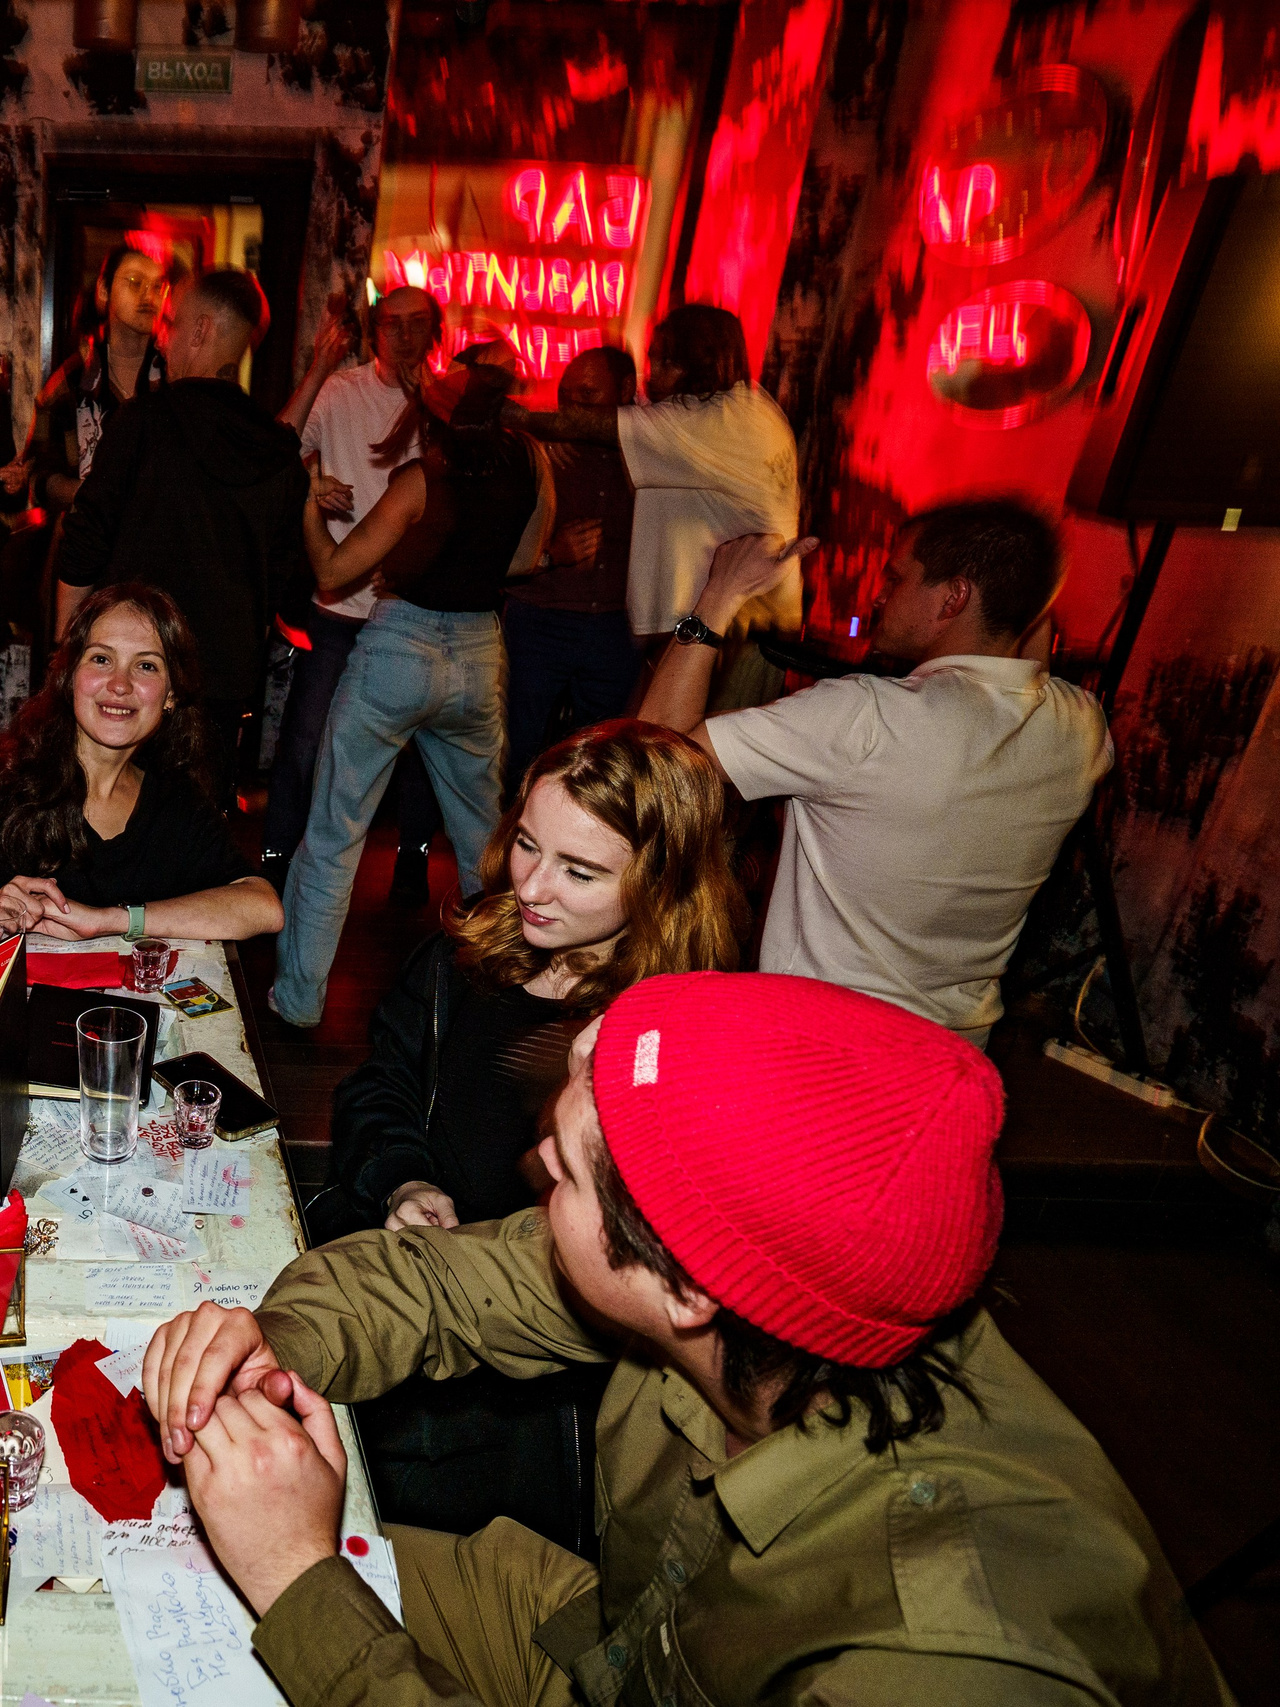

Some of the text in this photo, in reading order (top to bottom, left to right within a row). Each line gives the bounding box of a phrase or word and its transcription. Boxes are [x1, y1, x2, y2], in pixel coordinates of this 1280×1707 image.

[147, 61, 223, 86] ВЫХОД
[166, 1139, 185, 1162] ТЕБЯ
[193, 1282, 203, 1292] Я
